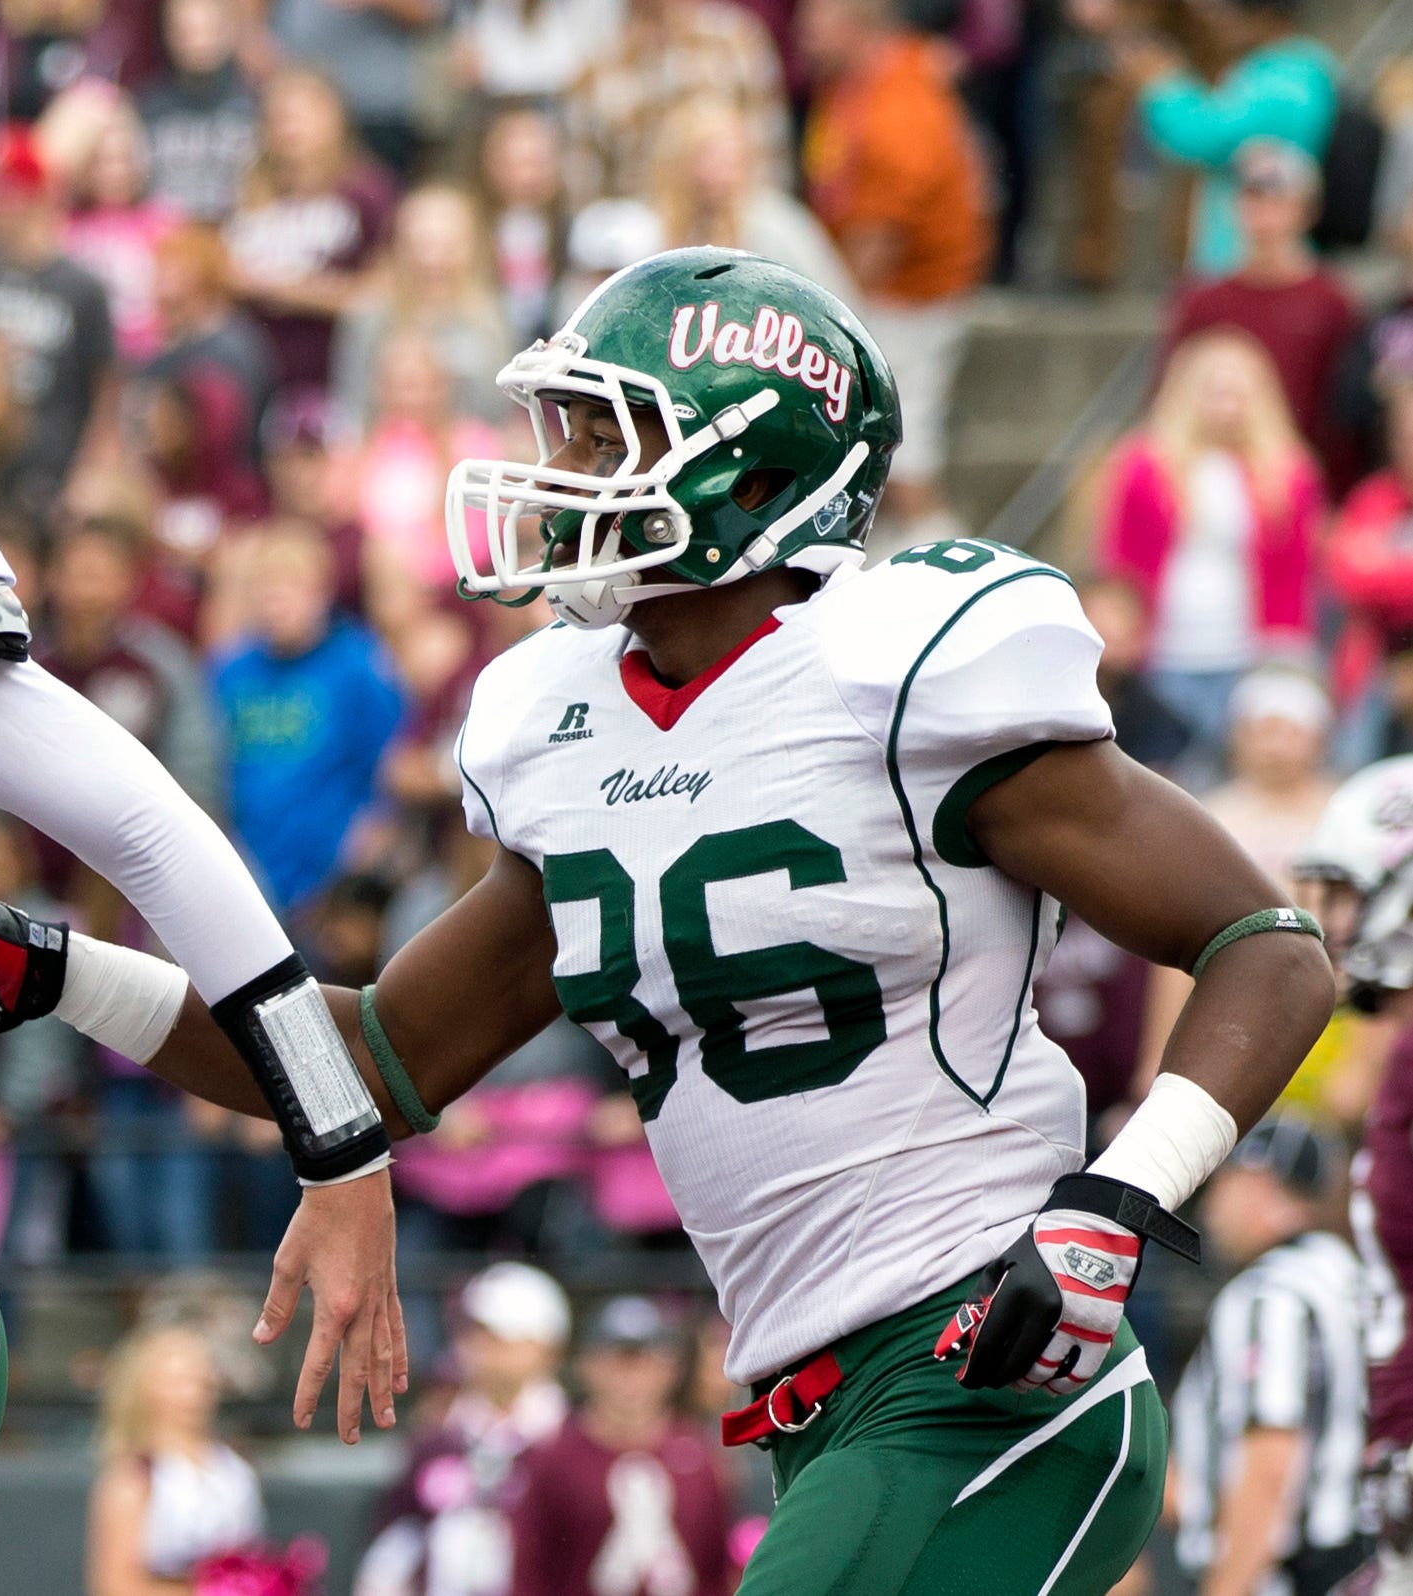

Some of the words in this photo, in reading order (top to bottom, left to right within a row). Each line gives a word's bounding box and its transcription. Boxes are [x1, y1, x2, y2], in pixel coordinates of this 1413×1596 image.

[668, 300, 854, 424] Valley
[548, 728, 594, 743] RUSSELL
[557, 702, 590, 731] R
[600, 763, 713, 806] Valley
[542, 818, 888, 1124] 86
